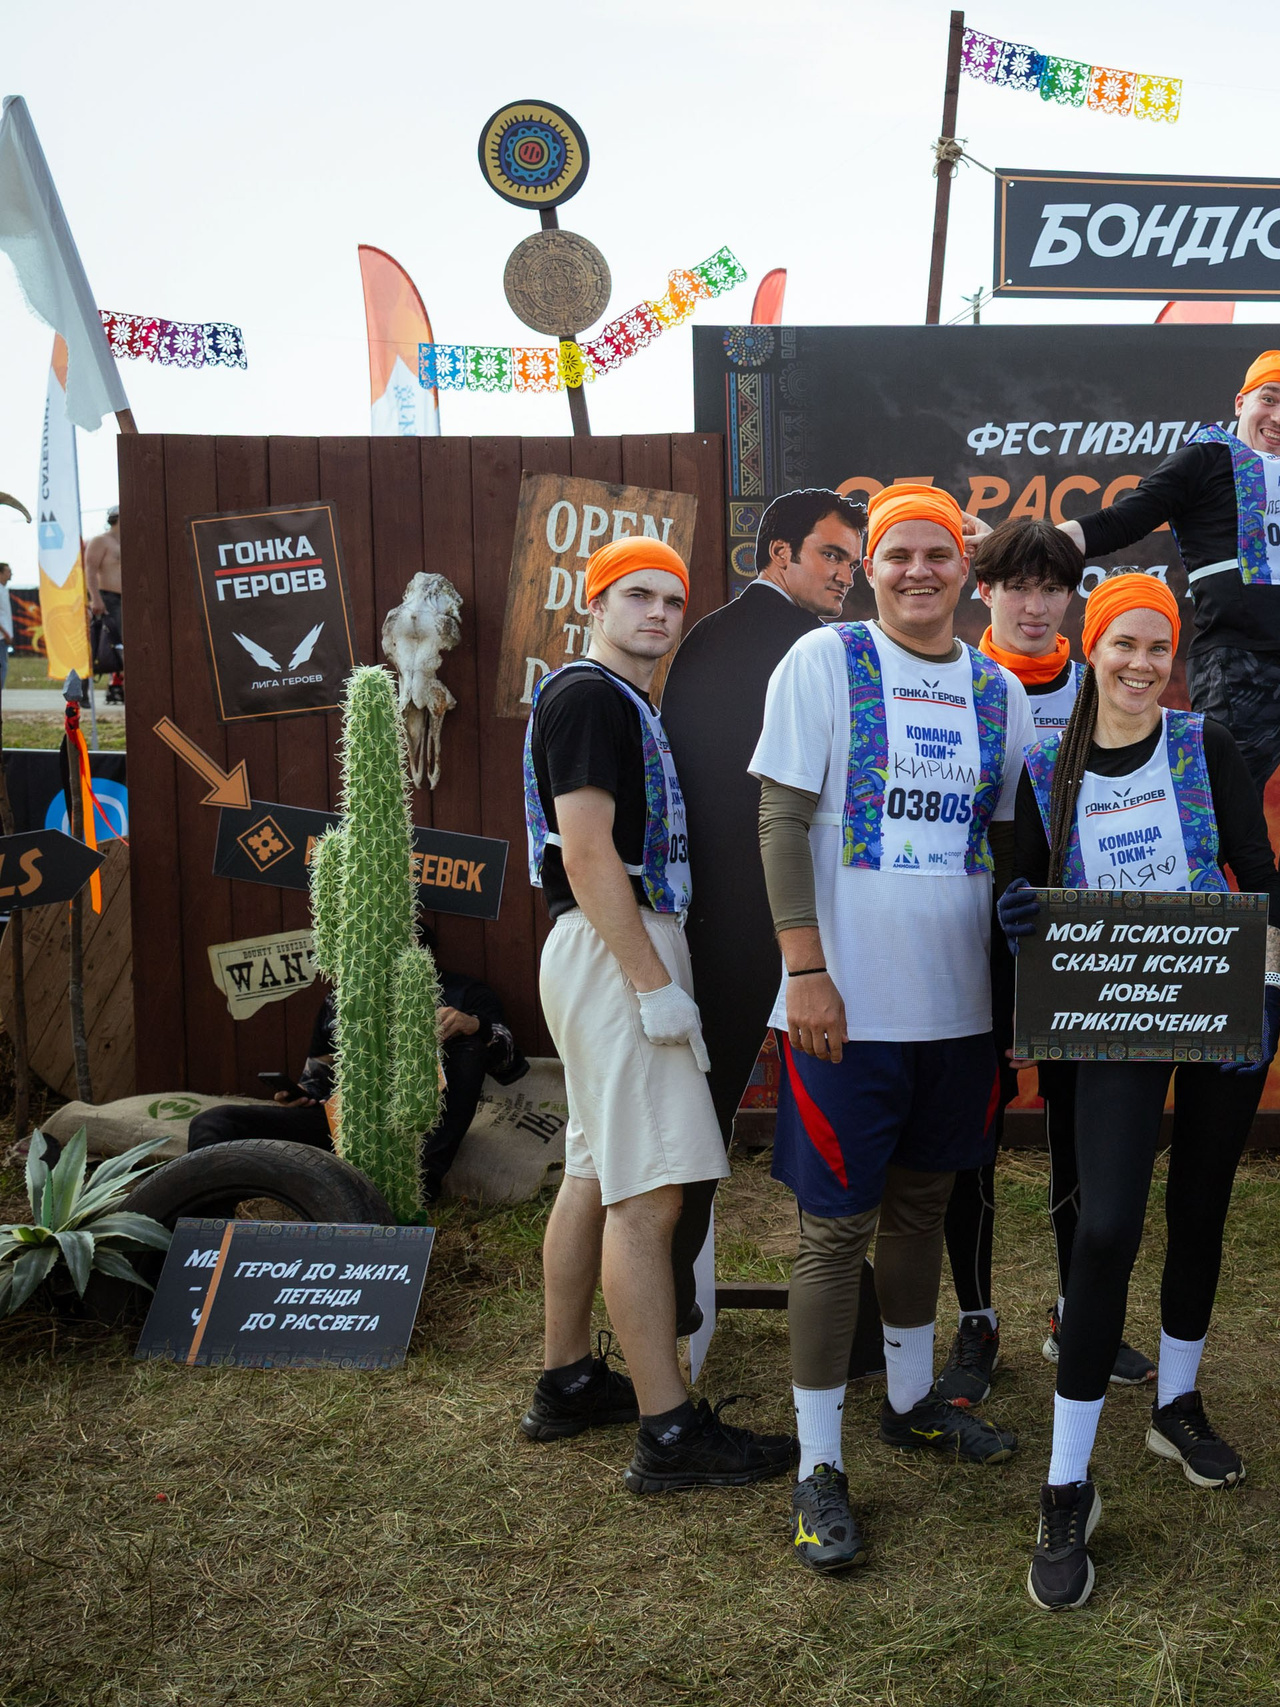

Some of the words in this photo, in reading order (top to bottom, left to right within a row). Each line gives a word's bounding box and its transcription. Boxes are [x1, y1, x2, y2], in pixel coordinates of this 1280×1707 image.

[218, 535, 315, 566] ГОНКА
[216, 568, 327, 601] ГЕРОЕВ
[251, 680, 279, 690] ЛИГА
[282, 674, 323, 686] ГЕРОЕВ
[893, 688, 929, 699] ГОНКА
[932, 691, 966, 705] ГЕРОЕВ
[906, 725, 962, 746] КОМАНДА
[914, 743, 956, 760] 10КМ+
[887, 788, 973, 824] 03805
[1085, 802, 1120, 814] ГОНКА
[1123, 789, 1166, 807] ГЕРОЕВ
[1098, 826, 1162, 852] КОМАНДА
[1109, 846, 1156, 866] 10КМ+
[1045, 920, 1105, 942] МОЙ
[1110, 924, 1240, 945] ПСИХОЛОГ
[1051, 953, 1138, 972] СКАЗАЛ
[1142, 954, 1231, 974] ИСКАТЬ
[1098, 983, 1182, 1003] НОВЫЕ
[1050, 1012, 1228, 1033] ПРИКЛЮЧЕНИЯ
[234, 1259, 303, 1279] ГЕРОЙ
[302, 1263, 335, 1281] ДО
[274, 1288, 361, 1307] ЛЕГЕНДА
[240, 1313, 275, 1332] ДО
[280, 1313, 380, 1331] РАССВЕТА
